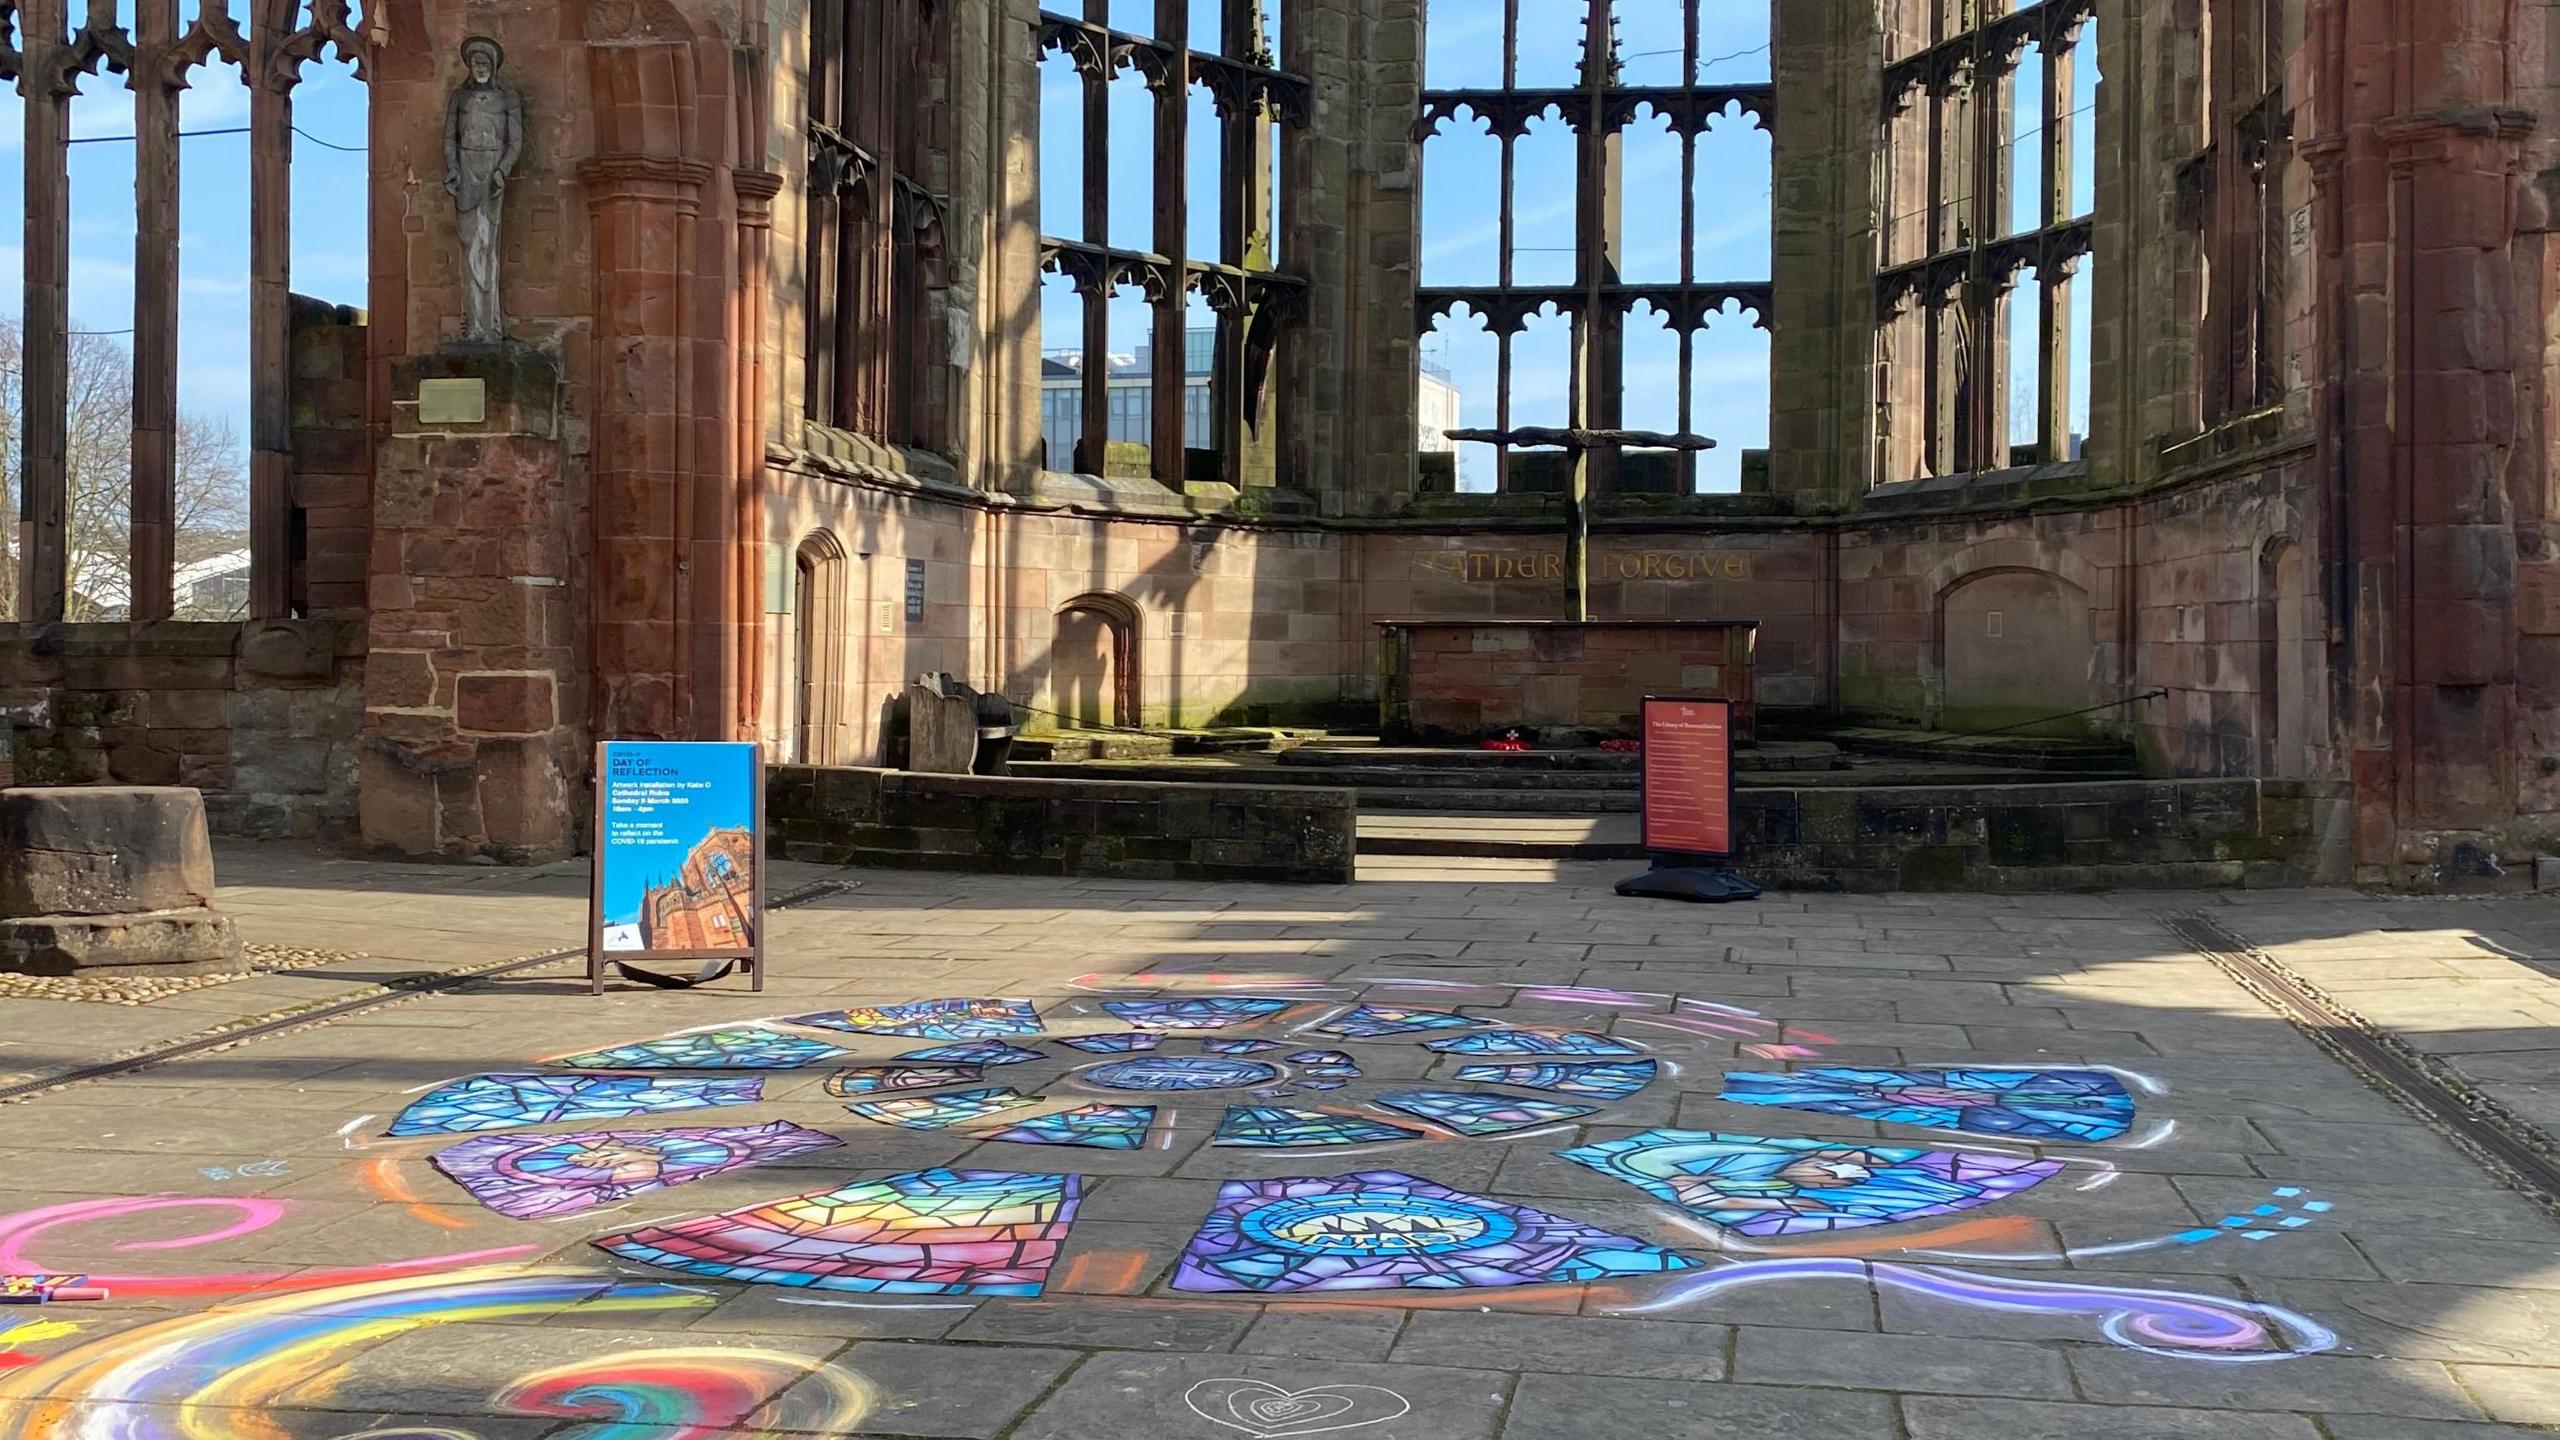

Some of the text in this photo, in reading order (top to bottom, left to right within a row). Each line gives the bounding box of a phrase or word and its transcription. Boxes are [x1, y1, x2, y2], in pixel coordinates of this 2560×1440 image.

[1602, 552, 1746, 579] FORGIVE
[612, 759, 652, 767] DAY OF
[612, 768, 679, 776] REFLECTION
[611, 797, 640, 805] Sunday
[645, 838, 680, 846] pandemic
